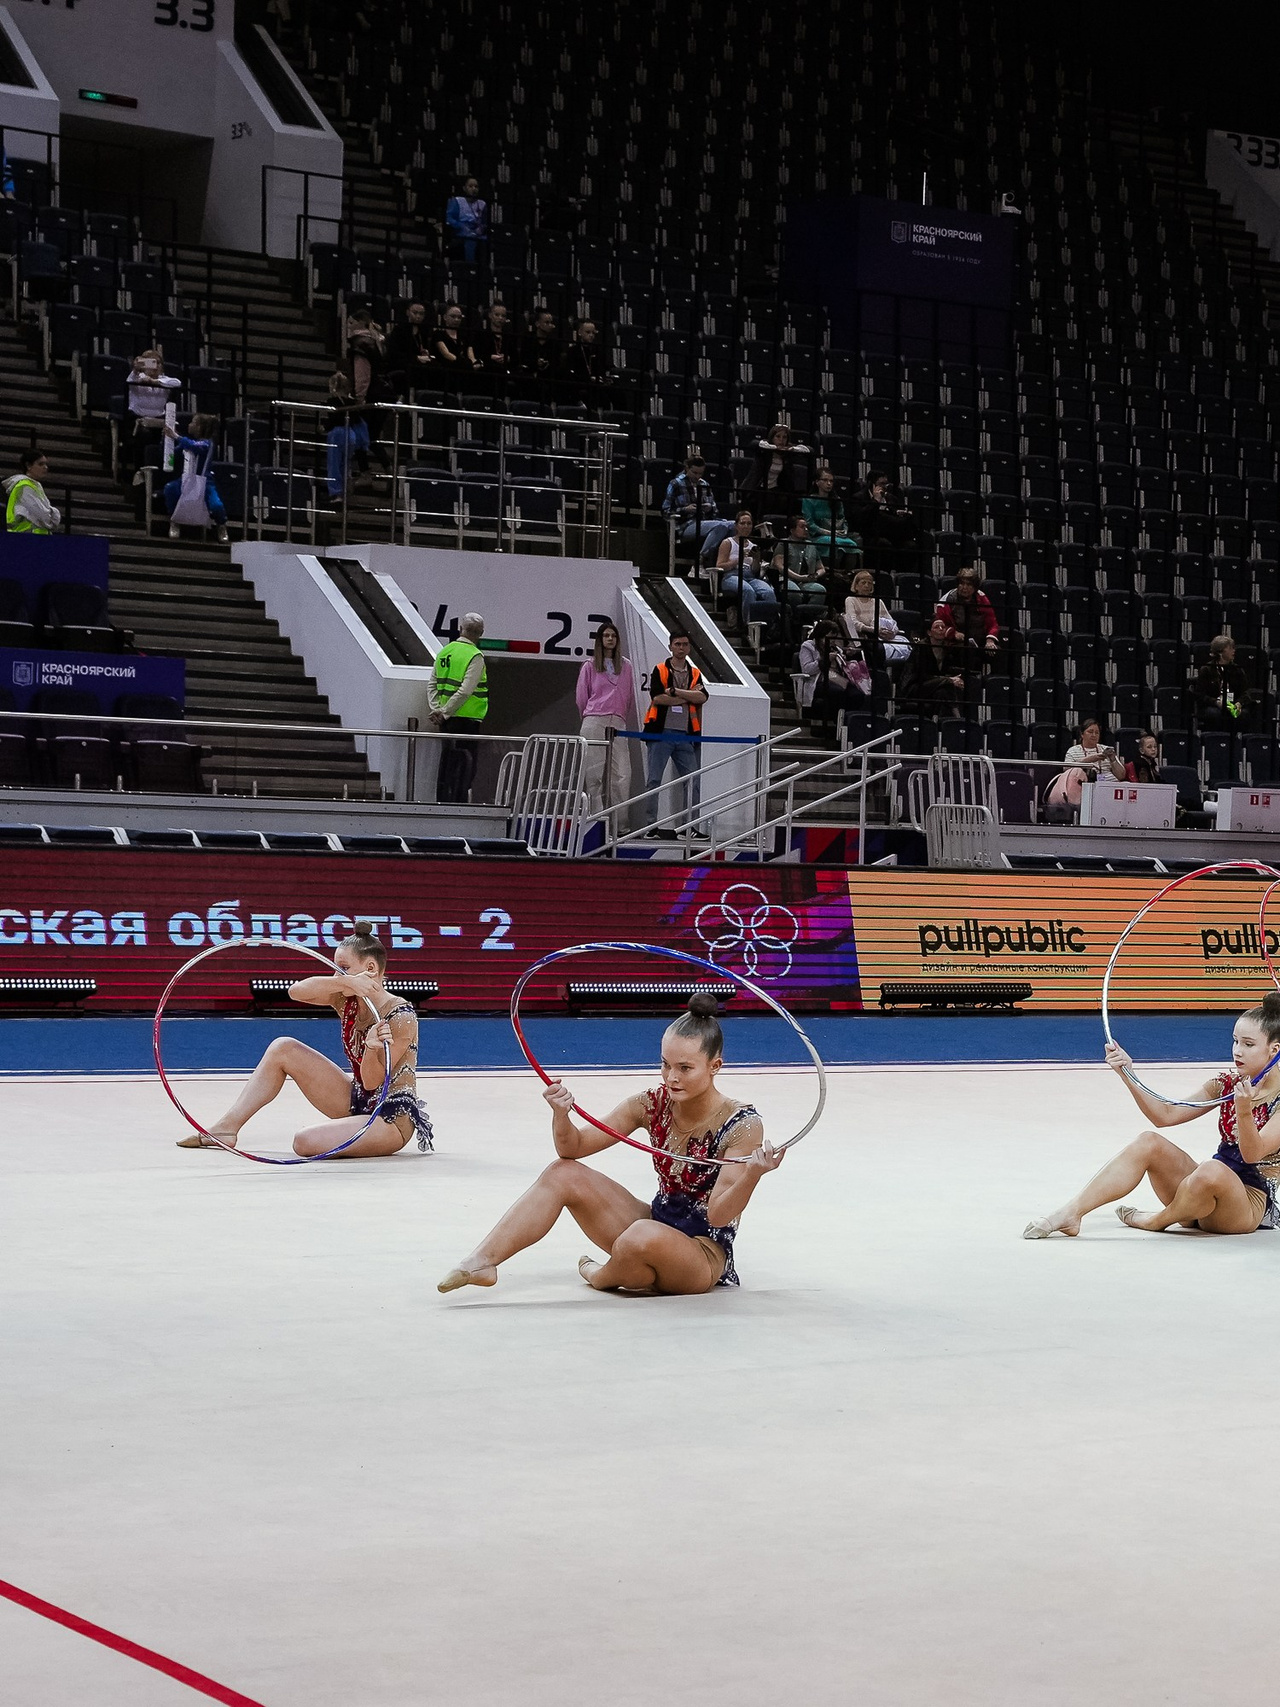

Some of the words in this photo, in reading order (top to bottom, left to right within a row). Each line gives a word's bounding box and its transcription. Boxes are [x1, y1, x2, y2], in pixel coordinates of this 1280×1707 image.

[912, 224, 982, 242] КРАСНОЯРСКИЙ
[912, 234, 936, 245] КРАЙ
[42, 663, 136, 678] КРАСНОЯРСКИЙ
[42, 674, 73, 685] КРАЙ
[169, 900, 424, 949] область
[439, 926, 462, 936] -
[480, 908, 515, 950] 2
[918, 919, 1086, 957] pullpublic
